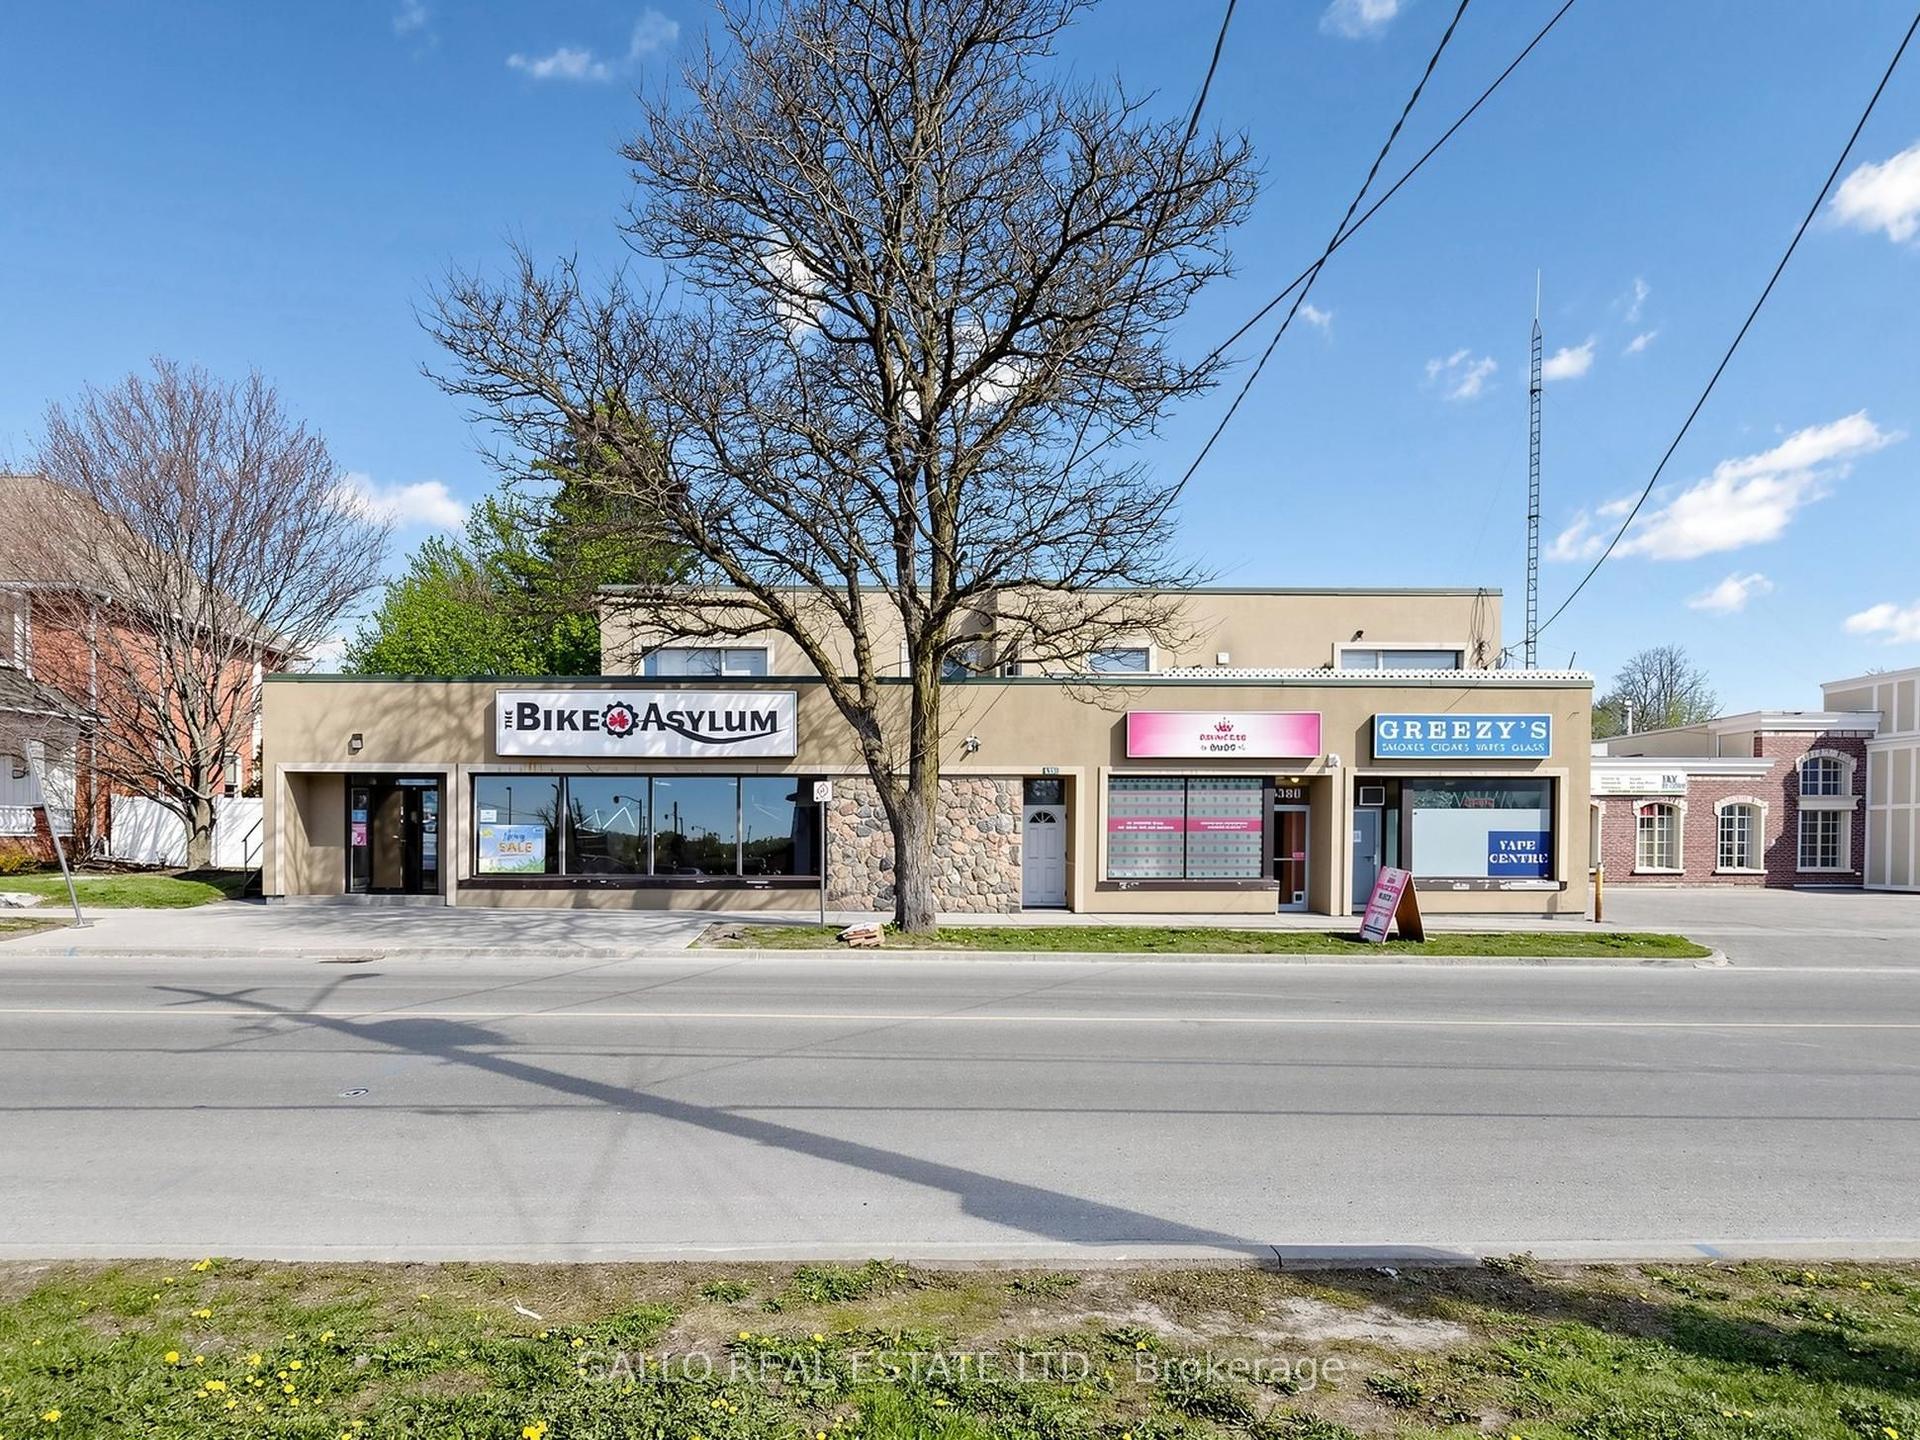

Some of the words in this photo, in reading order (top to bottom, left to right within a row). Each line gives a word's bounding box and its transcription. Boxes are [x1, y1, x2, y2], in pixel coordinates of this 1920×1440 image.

[504, 709, 513, 729] THE
[515, 702, 600, 731] BIKE
[1379, 720, 1547, 739] GREEZY'S
[1382, 743, 1425, 752] SMOKES
[498, 842, 533, 853] SALE
[1499, 840, 1536, 851] VAPE
[1488, 853, 1549, 864] CENTRE
